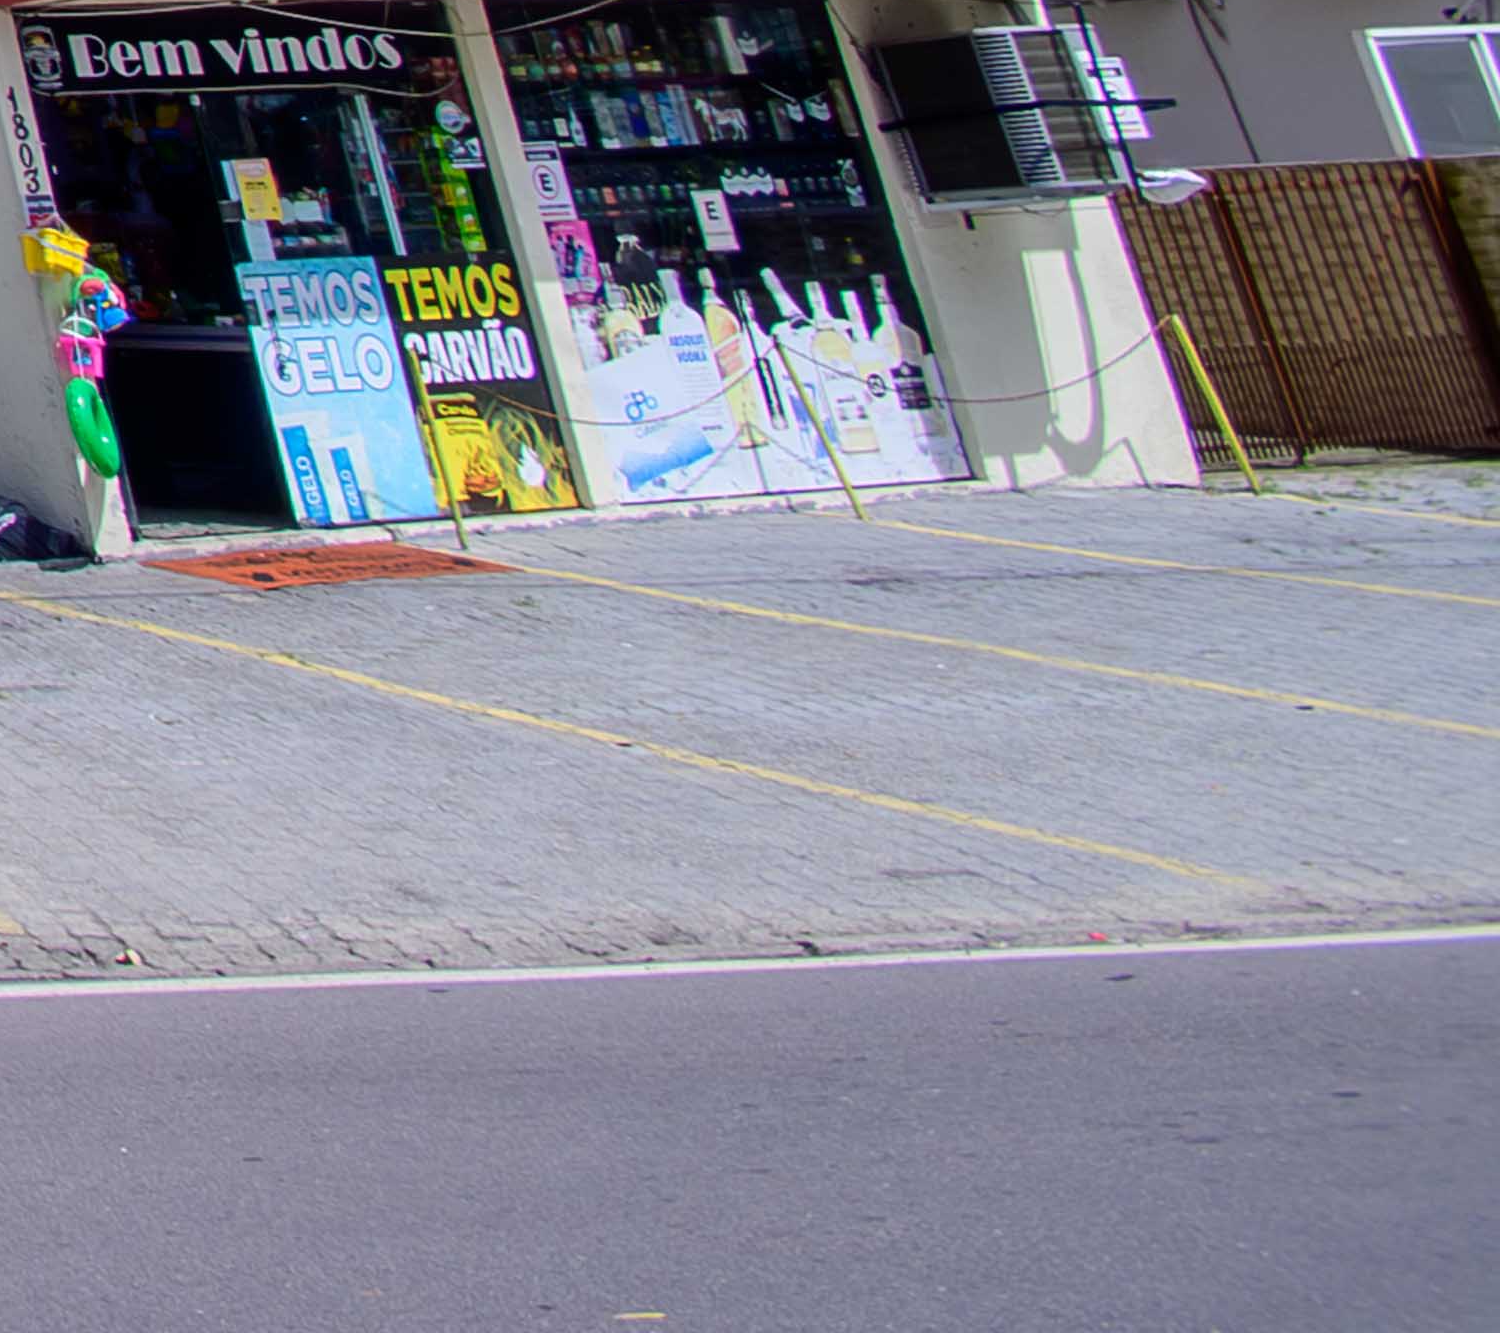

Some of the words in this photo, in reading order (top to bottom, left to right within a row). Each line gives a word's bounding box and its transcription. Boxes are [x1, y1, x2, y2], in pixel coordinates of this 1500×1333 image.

[67, 33, 204, 78] Bem
[209, 27, 402, 76] vindos
[7, 86, 40, 194] 1803
[538, 172, 554, 193] E
[703, 200, 720, 221] E
[243, 269, 382, 330] TEMOS
[384, 262, 521, 322] TEMOS
[262, 334, 394, 396] GELO
[403, 319, 535, 384] CARVÃO
[296, 456, 322, 506] GELO
